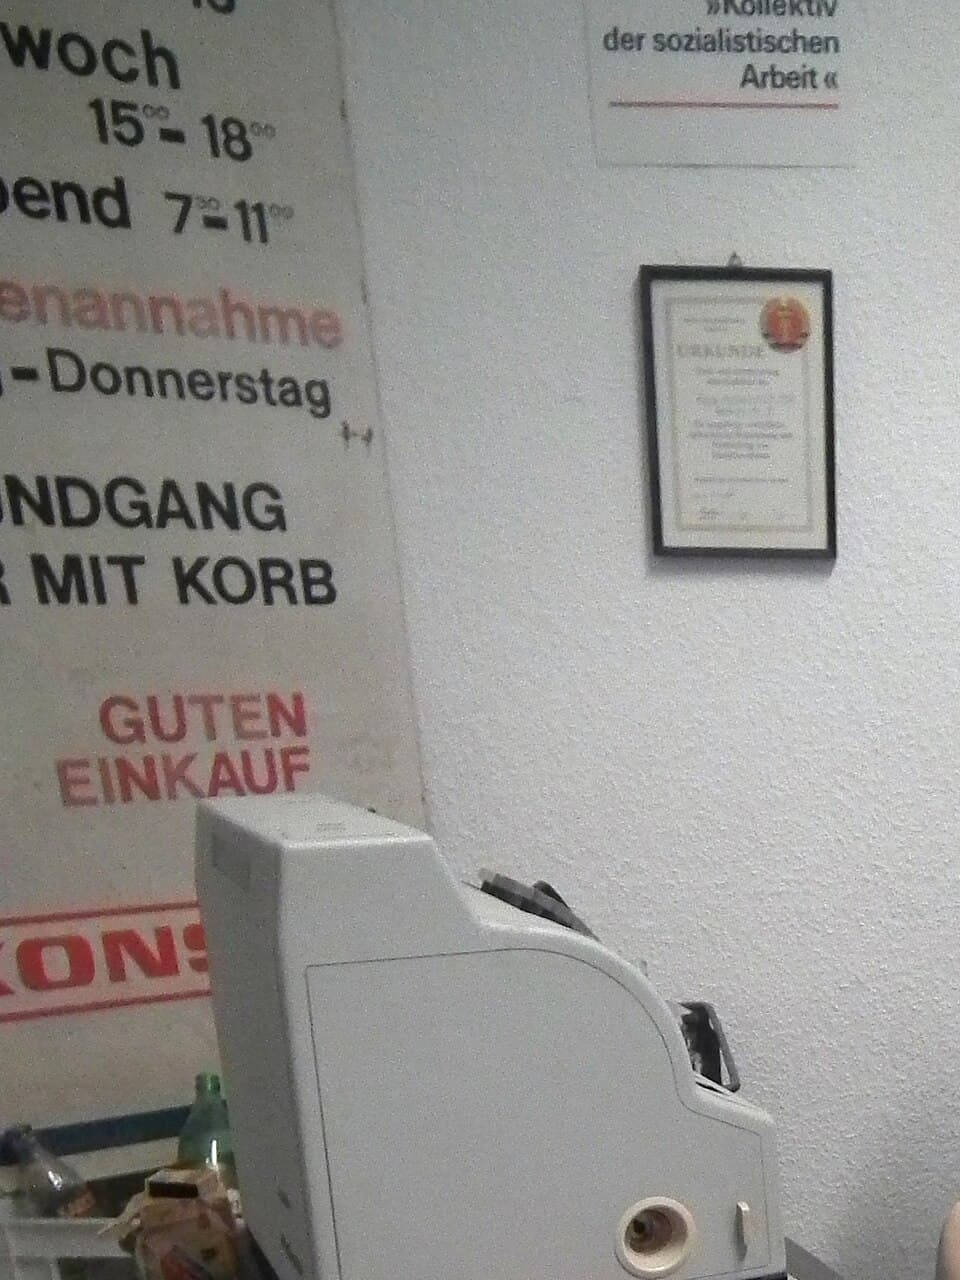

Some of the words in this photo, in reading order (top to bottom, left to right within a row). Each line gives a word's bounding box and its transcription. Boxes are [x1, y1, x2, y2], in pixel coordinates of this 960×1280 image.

[603, 26, 646, 52] der
[652, 27, 839, 54] sozialistischen
[740, 63, 818, 89] Arbeit
[0, 175, 131, 229] end
[0, 474, 287, 532] NDGANG
[30, 553, 145, 605] MIT
[172, 556, 337, 606] KORB
[100, 692, 308, 745] GUTEN
[56, 746, 311, 807] EINKAUF
[0, 922, 209, 996] ON
